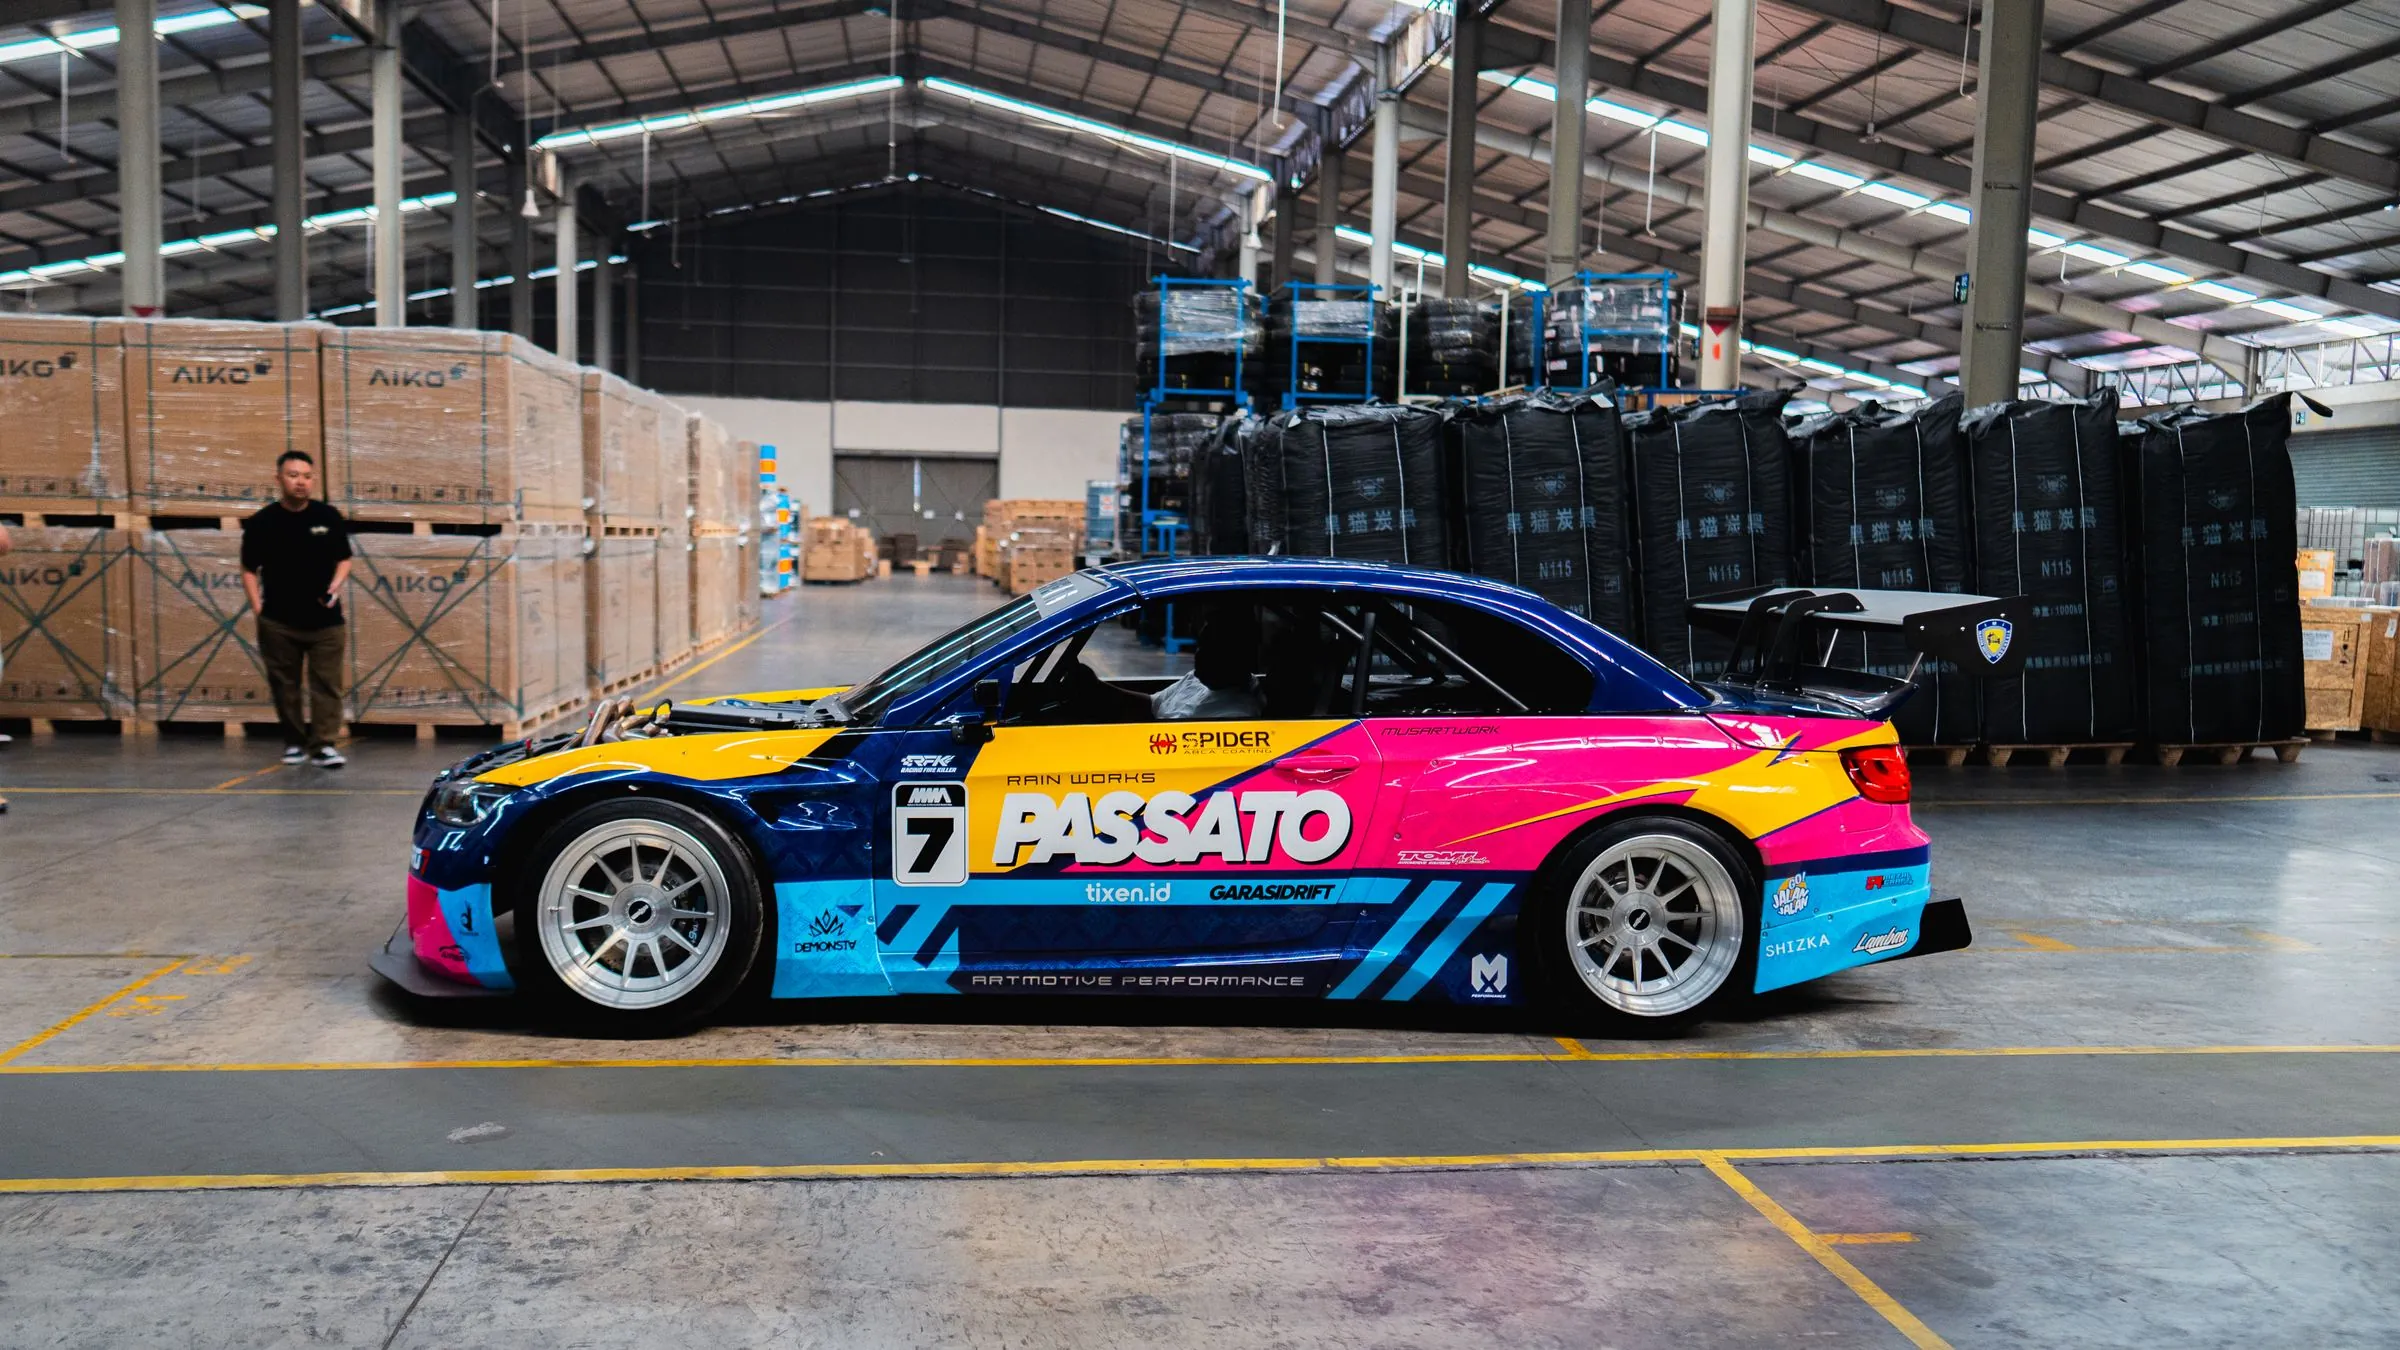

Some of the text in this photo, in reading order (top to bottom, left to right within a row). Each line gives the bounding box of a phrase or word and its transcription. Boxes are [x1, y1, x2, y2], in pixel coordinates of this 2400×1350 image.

[0, 360, 54, 377] IKO
[172, 366, 250, 385] AIKO
[369, 369, 446, 388] AIKO
[1539, 560, 1572, 580] N115
[1708, 563, 1741, 583] N115
[1881, 567, 1913, 587] N115
[2041, 559, 2072, 578] N115
[179, 571, 242, 589] AIK
[376, 576, 448, 593] AIKO
[2210, 570, 2243, 589] N115
[1182, 731, 1270, 748] SPIDER
[1381, 726, 1501, 736] MUSARTWORK
[902, 755, 956, 767] RFK
[1007, 773, 1155, 786] RAIN WORKS
[992, 790, 1353, 866] PASSATO
[906, 817, 955, 874] 7
[1787, 871, 1807, 889] GO!
[1085, 882, 1171, 903] tixen.id
[1209, 884, 1337, 902] GARASIDRIFT
[1773, 885, 1809, 908] JALAN
[1777, 897, 1808, 916] JALAN
[1766, 934, 1831, 958] SHIZKA
[972, 975, 1305, 987] ARTMOTIVE PERFORMANCE
